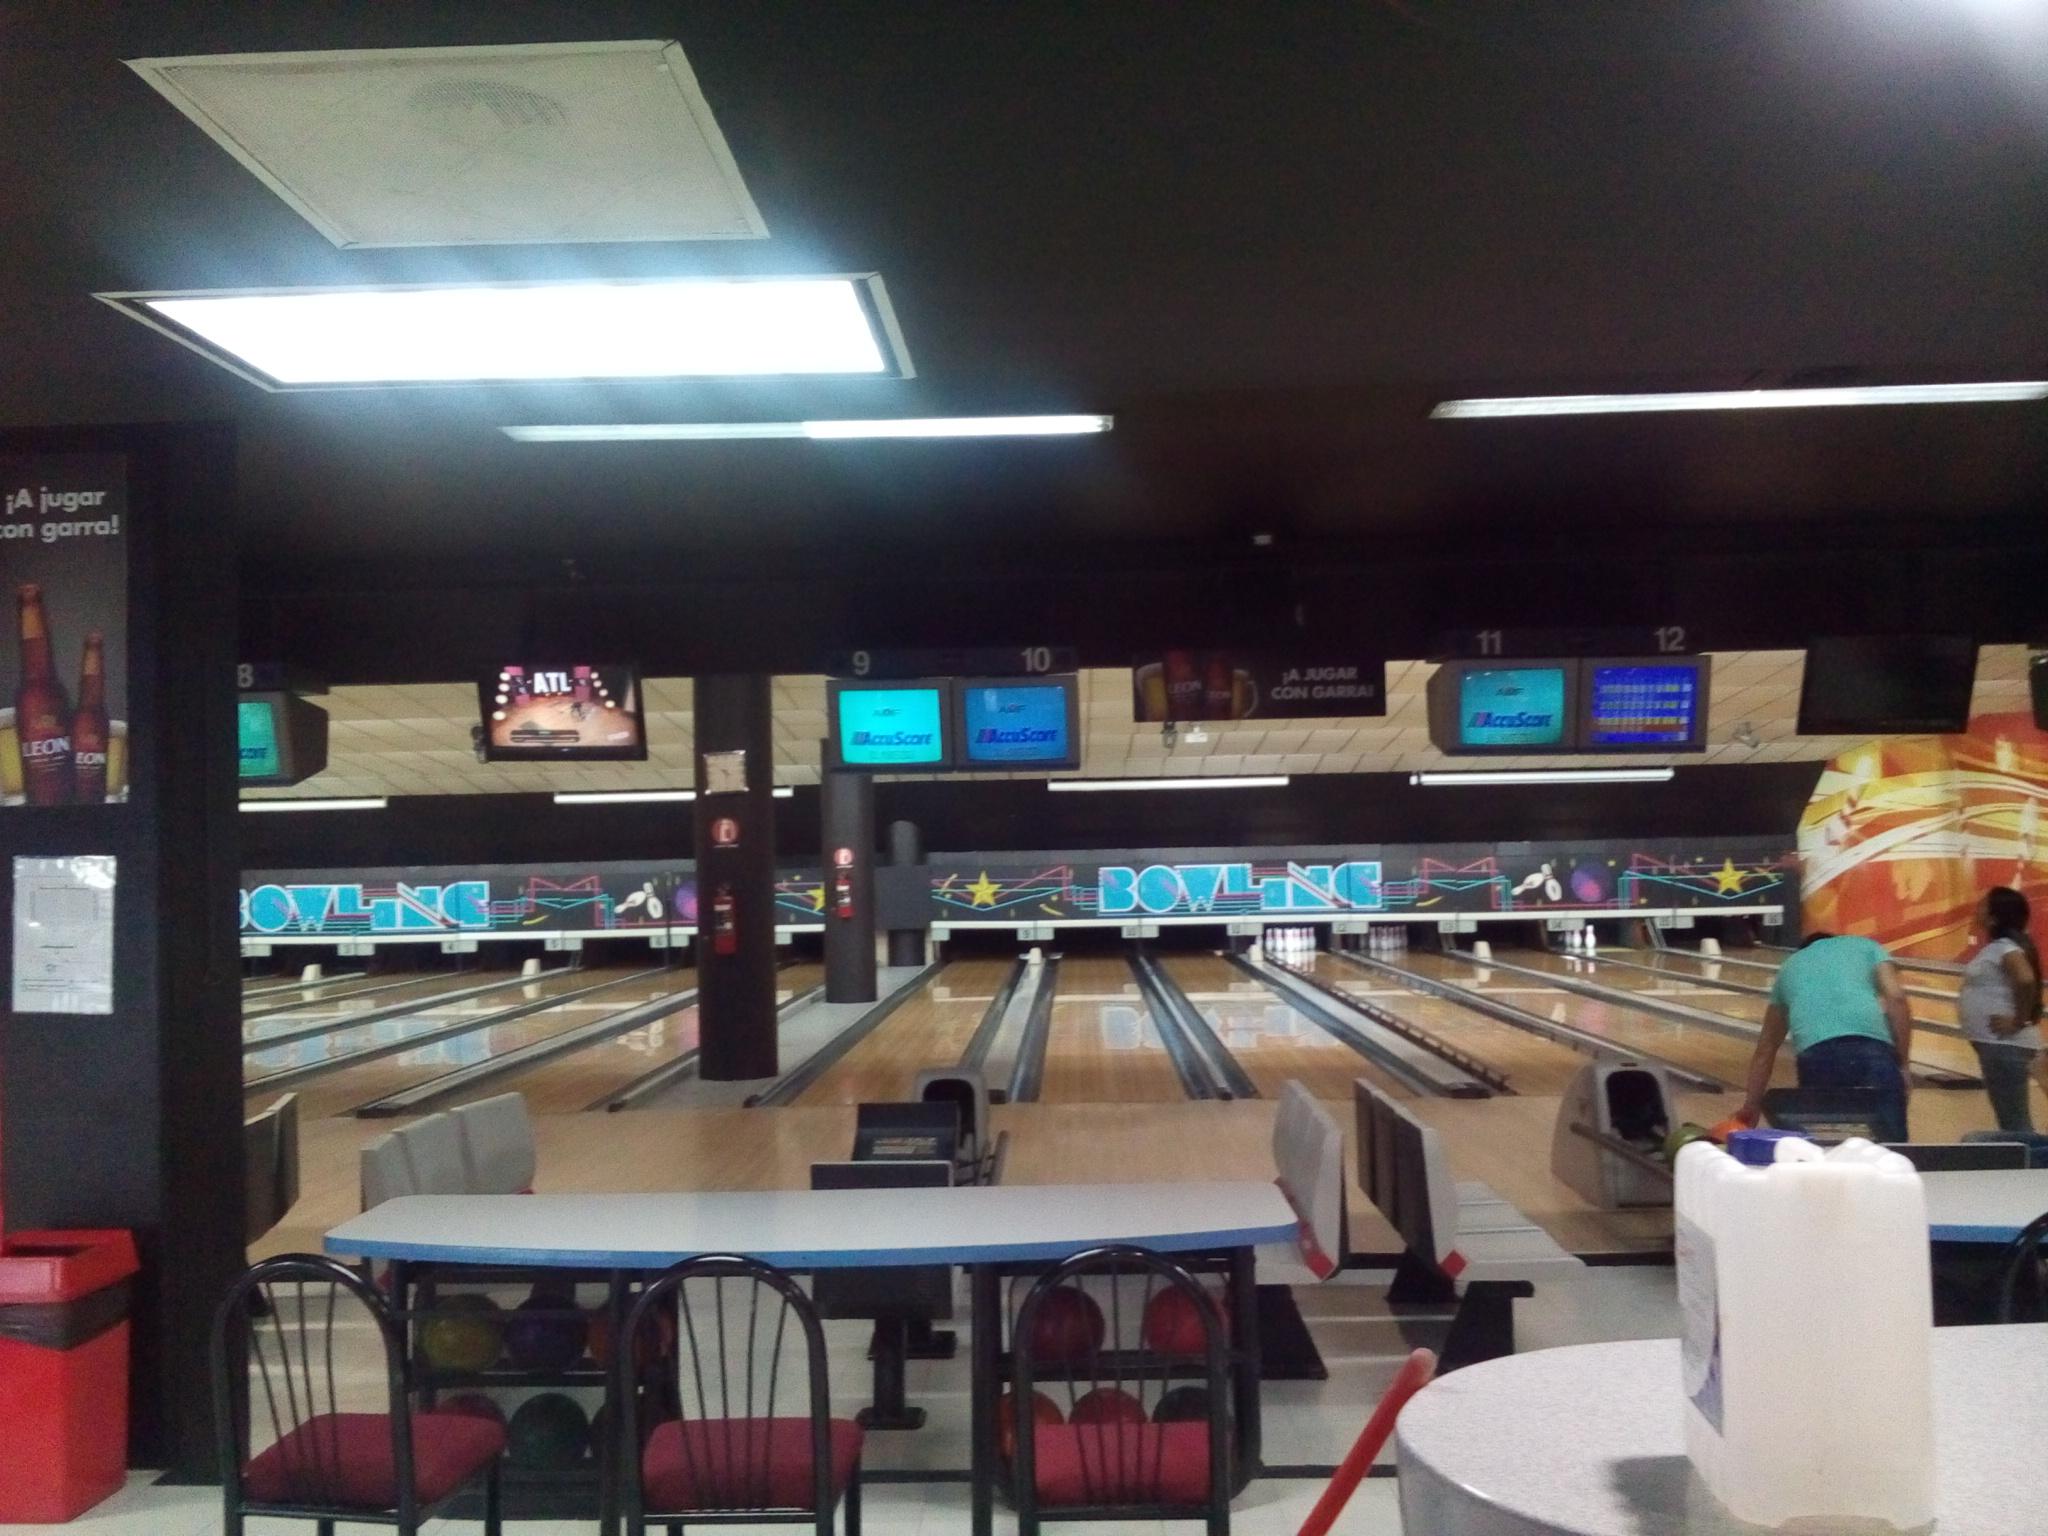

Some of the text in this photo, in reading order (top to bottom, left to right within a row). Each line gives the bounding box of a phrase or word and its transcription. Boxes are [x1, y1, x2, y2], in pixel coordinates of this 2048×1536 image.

[6, 486, 107, 514] ¡A jugar
[0, 514, 119, 543] on garra!
[1476, 630, 1501, 655] 11
[1654, 626, 1685, 652] 12
[853, 650, 870, 675] 9
[1021, 647, 1050, 672] 10
[238, 663, 254, 688] 8
[533, 671, 572, 694] ATL
[1304, 667, 1358, 681] JUGAR
[1271, 685, 1374, 700] CON GARRA!
[1099, 861, 1382, 913] BOWLING
[239, 880, 490, 933] OWLING
